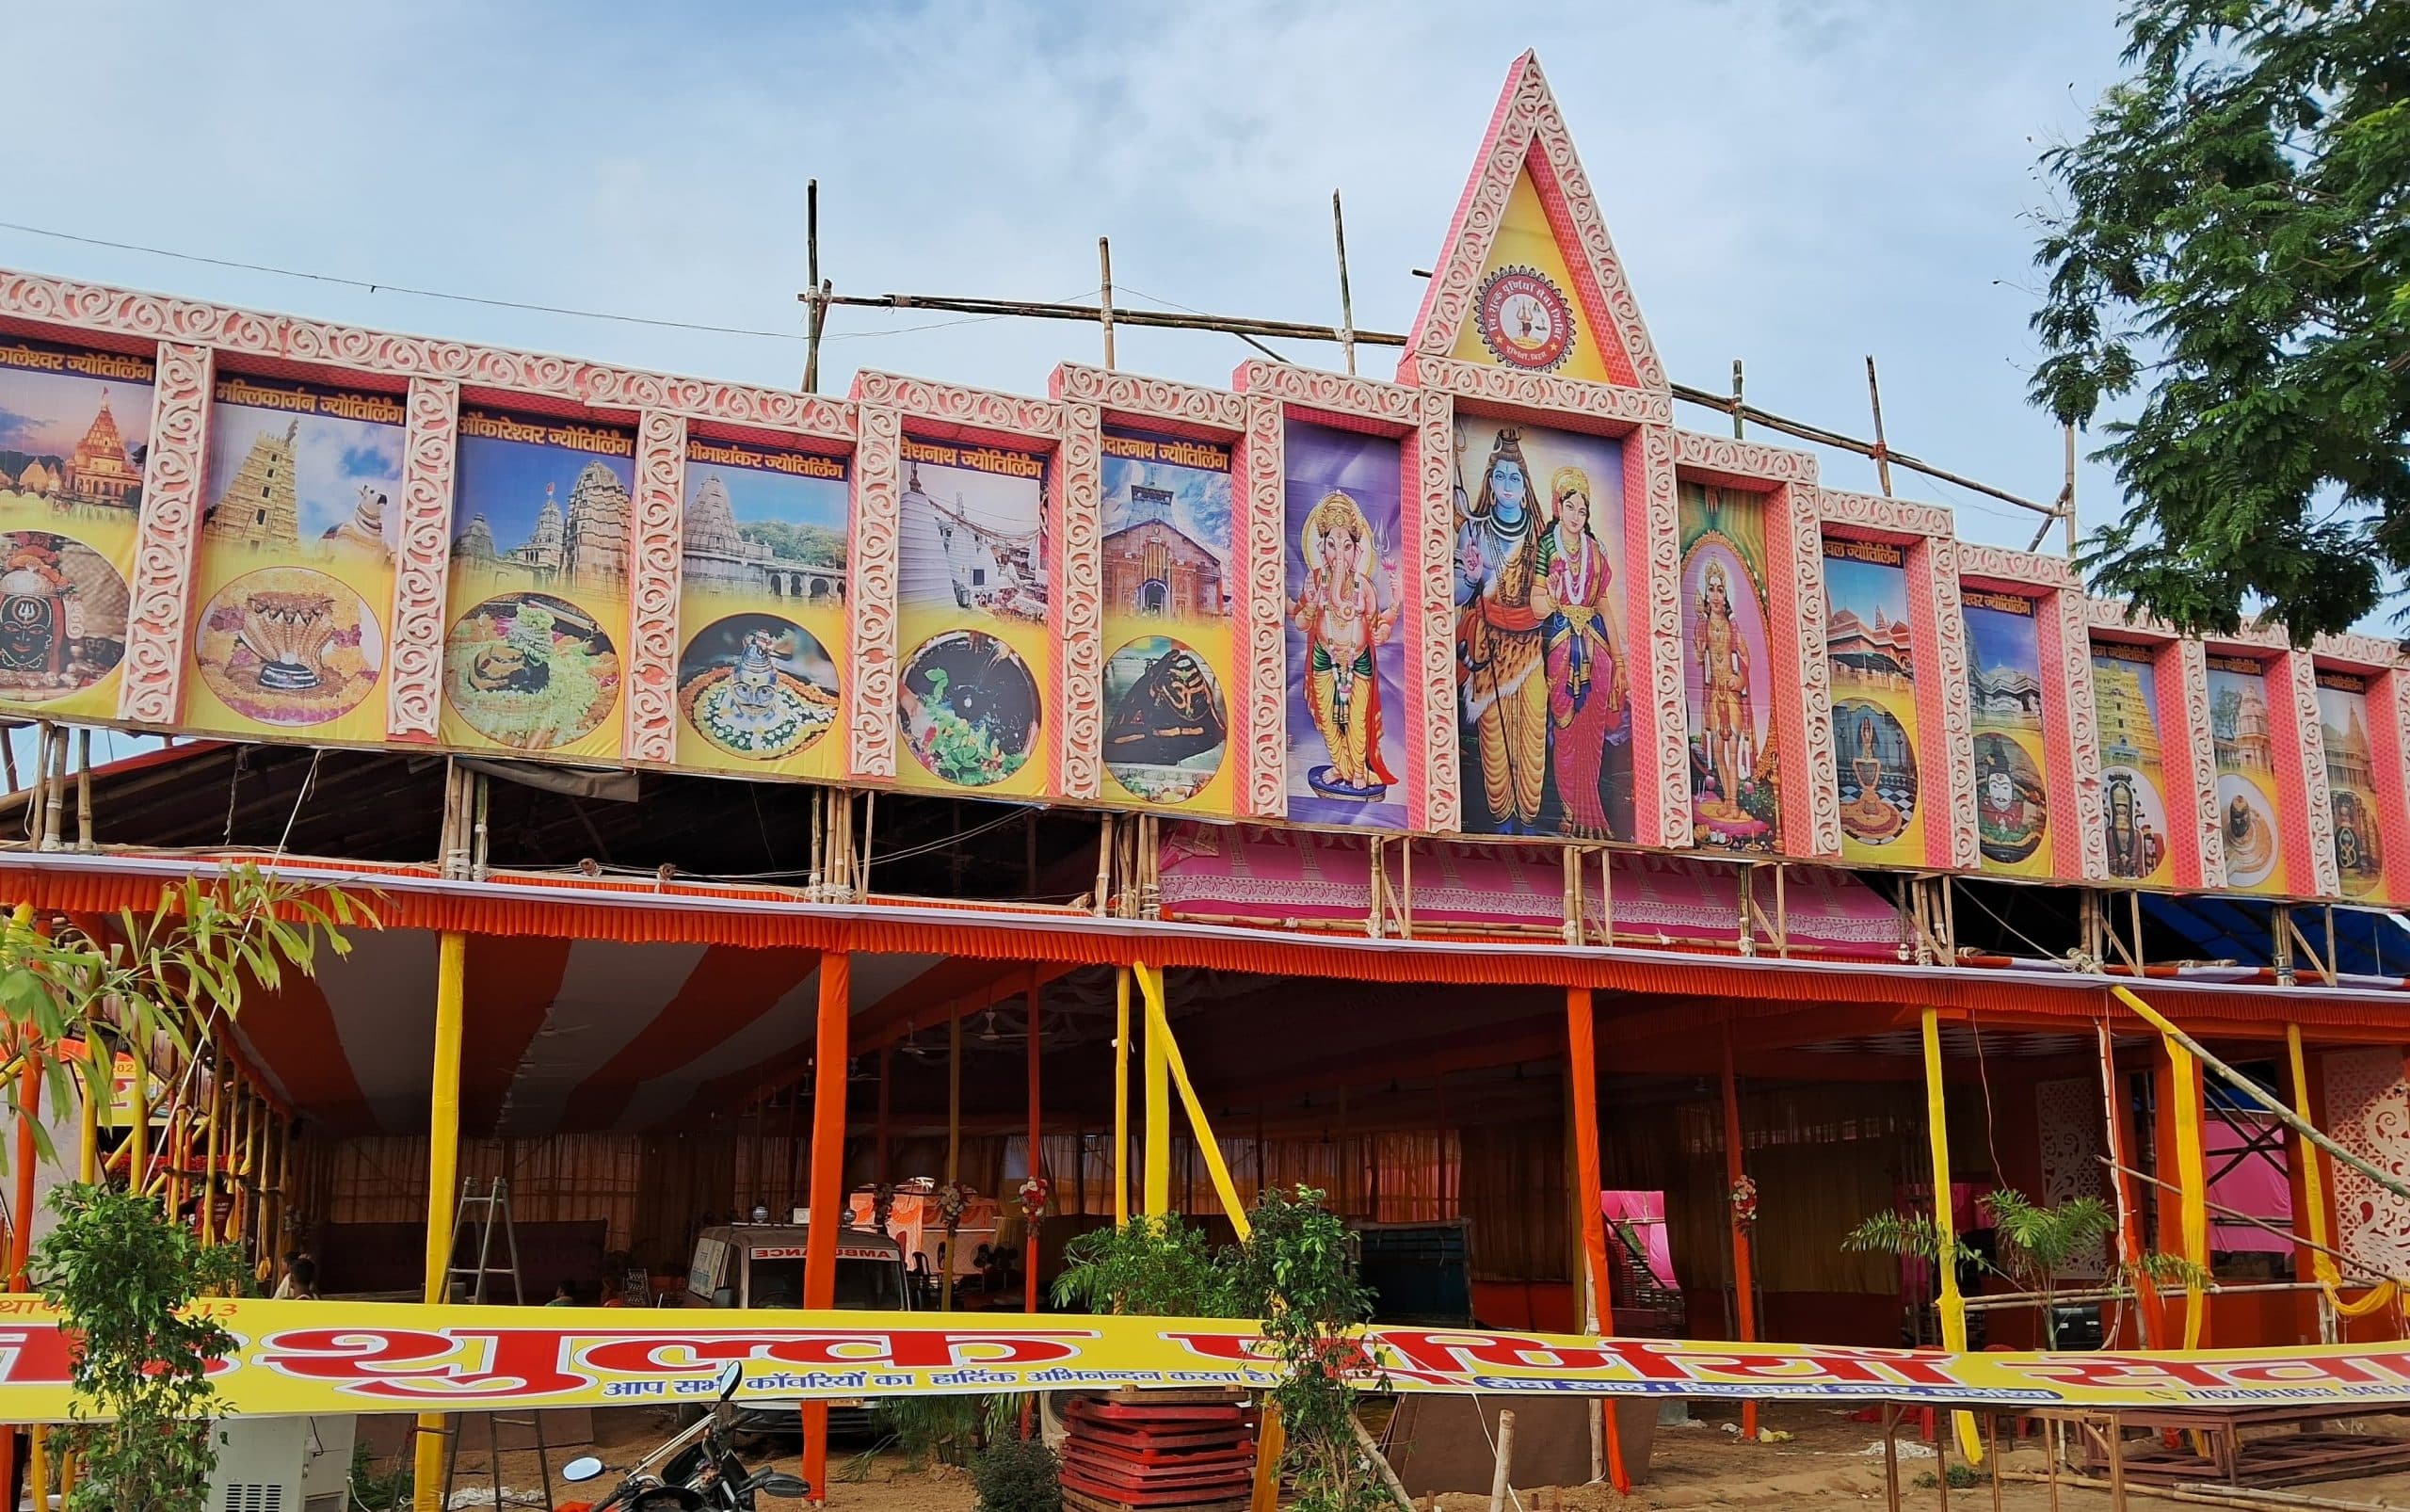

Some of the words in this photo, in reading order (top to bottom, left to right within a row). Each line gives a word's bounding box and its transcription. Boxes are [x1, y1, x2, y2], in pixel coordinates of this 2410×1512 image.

[602, 1379, 667, 1397] आप
[873, 1374, 914, 1388] का
[930, 1368, 1019, 1386] हार्दिक
[1026, 1367, 1165, 1383] अभिनन्दन
[1167, 1369, 1242, 1383] करता
[1482, 1376, 1557, 1390] सेवा
[1561, 1379, 1647, 1392] स्थल
